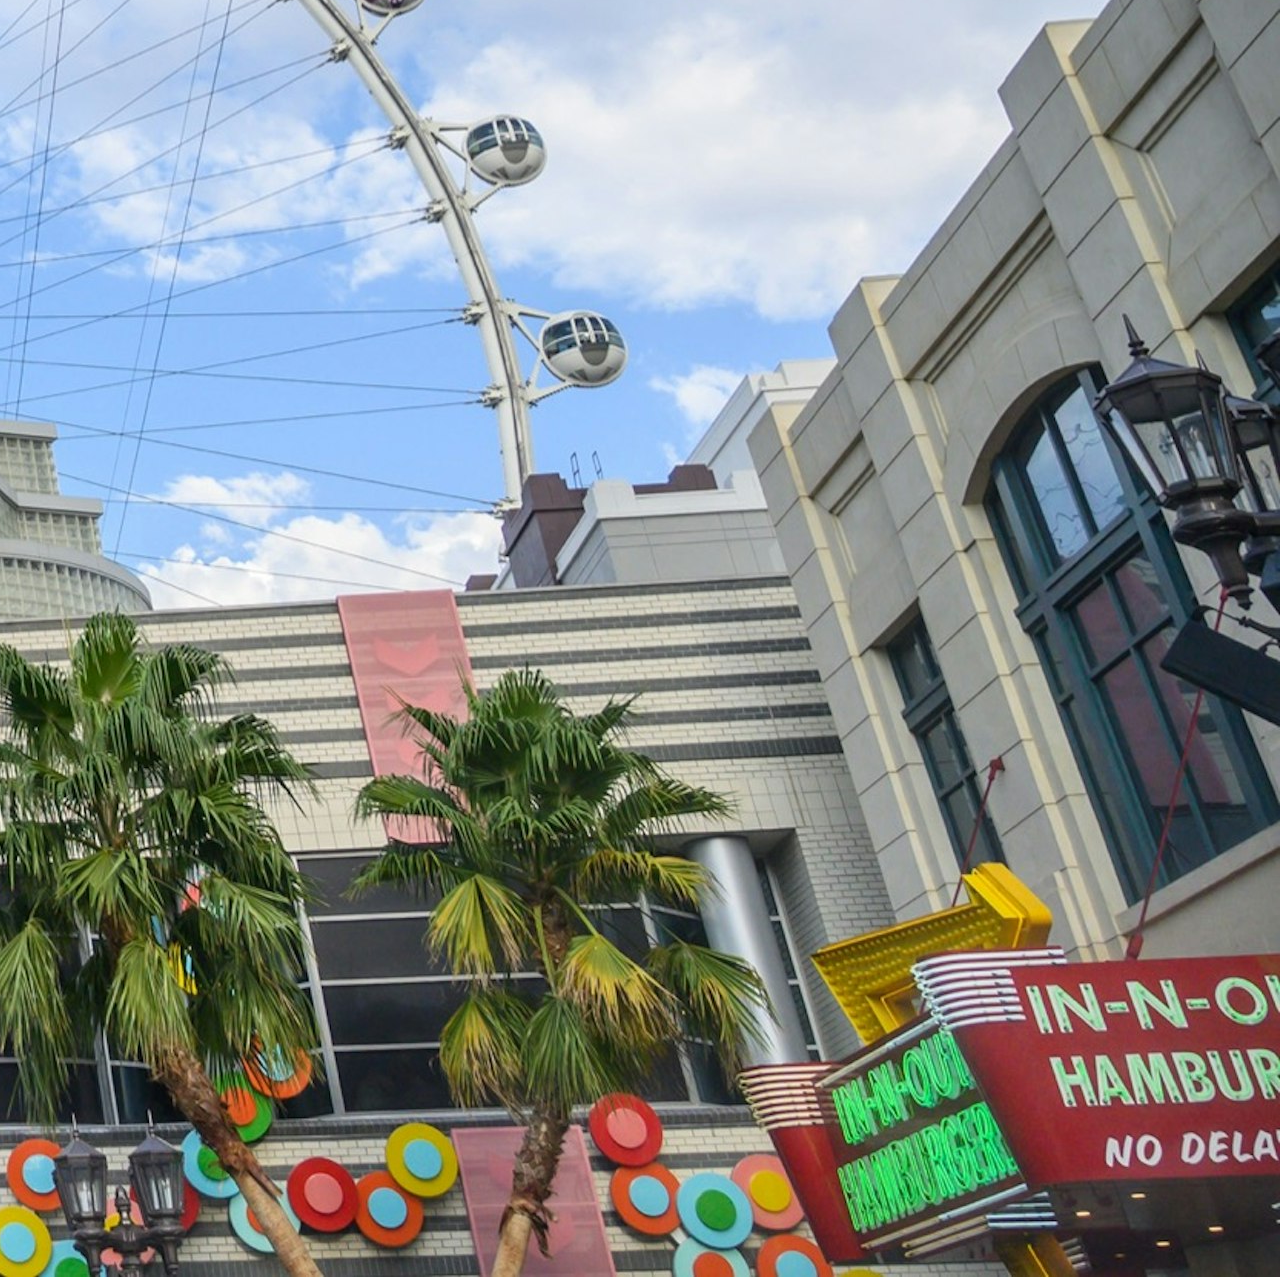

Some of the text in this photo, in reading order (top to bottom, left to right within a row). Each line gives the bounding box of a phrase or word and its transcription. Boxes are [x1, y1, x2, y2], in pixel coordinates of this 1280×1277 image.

[832, 1029, 975, 1145] IN-N-OUT
[837, 1102, 1020, 1234] HAMBURGER
[1106, 1129, 1280, 1168] NO DELA
